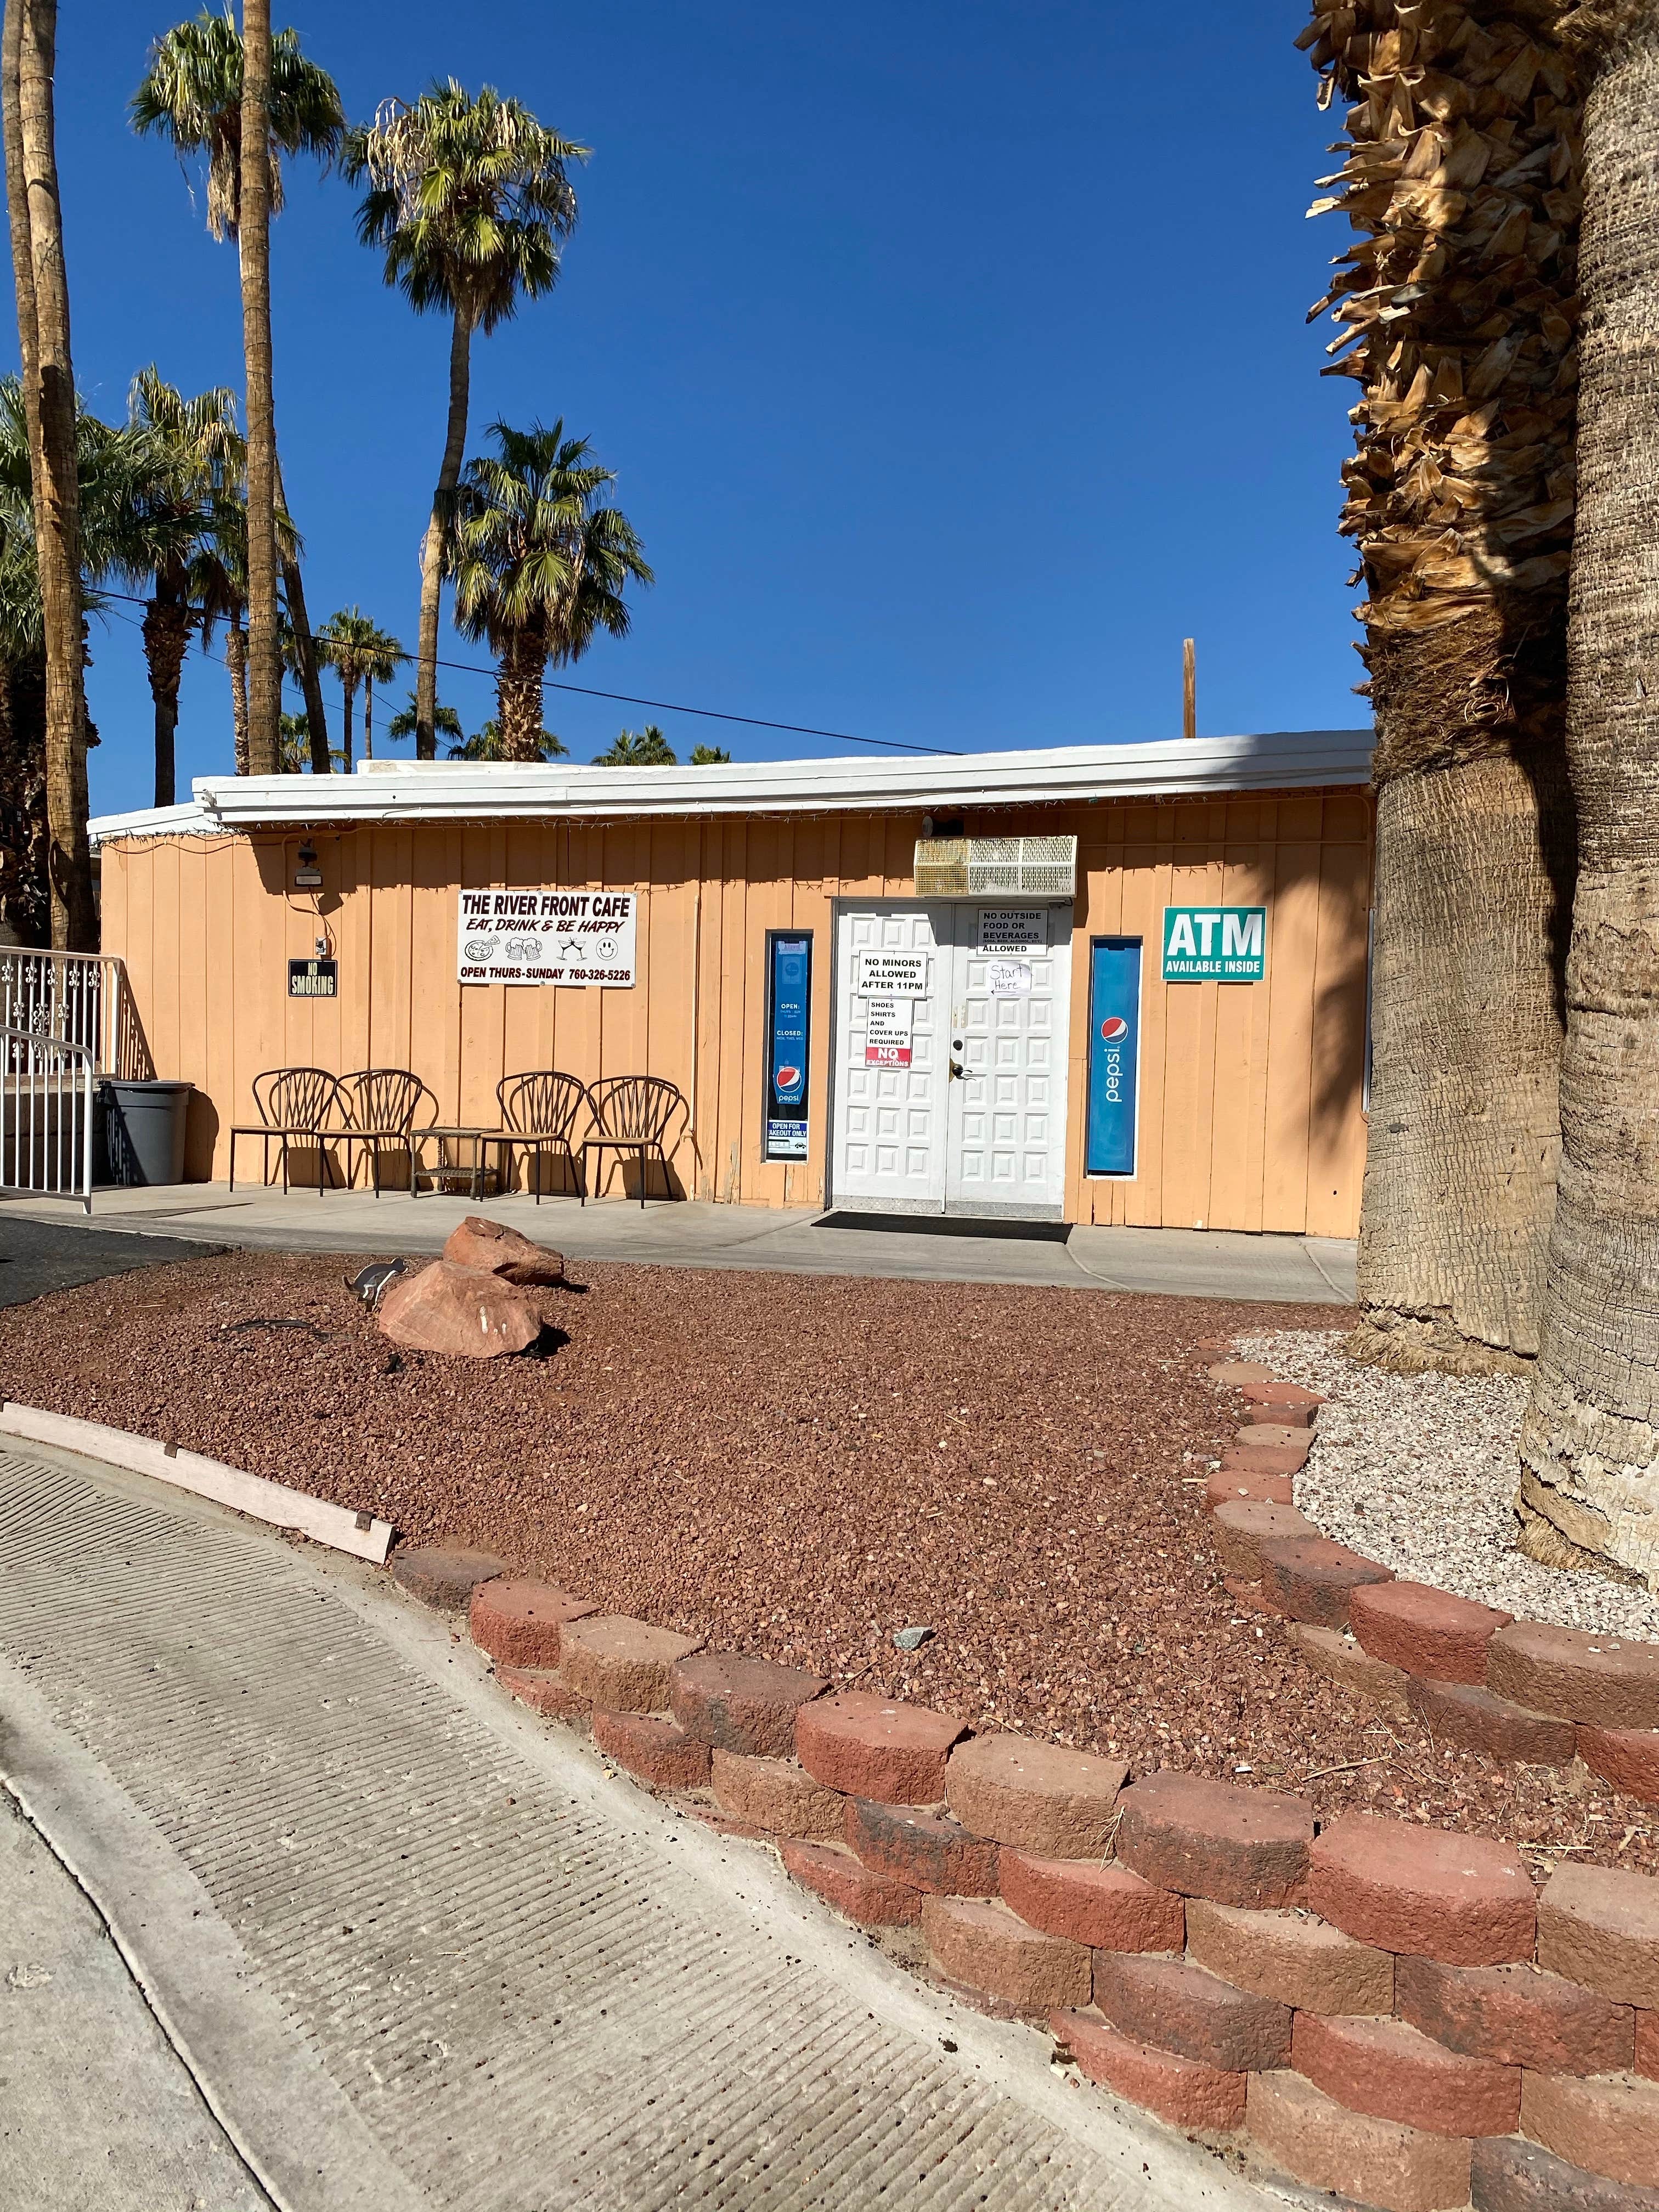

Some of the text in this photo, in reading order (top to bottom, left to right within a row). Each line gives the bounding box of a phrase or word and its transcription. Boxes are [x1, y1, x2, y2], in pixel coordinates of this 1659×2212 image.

[463, 895, 630, 917] THE RIVER FRONT CAFE
[466, 918, 625, 933] EAT, DRINK & BE HAPPY
[1166, 913, 1262, 956] ATM
[308, 962, 318, 976] NO
[882, 959, 922, 967] MINORS
[1166, 961, 1260, 973] AVAILABLE INSIDE
[461, 967, 487, 978] OPEN
[569, 969, 630, 980] 760-326-5226
[869, 970, 916, 978] ALLOWED
[990, 963, 1023, 980] Start
[292, 976, 334, 995] SMOKING
[861, 981, 894, 989] AFTER
[995, 980, 1019, 990] Here
[1104, 1048, 1124, 1102] pepsi
[779, 1094, 799, 1103] pepsi
